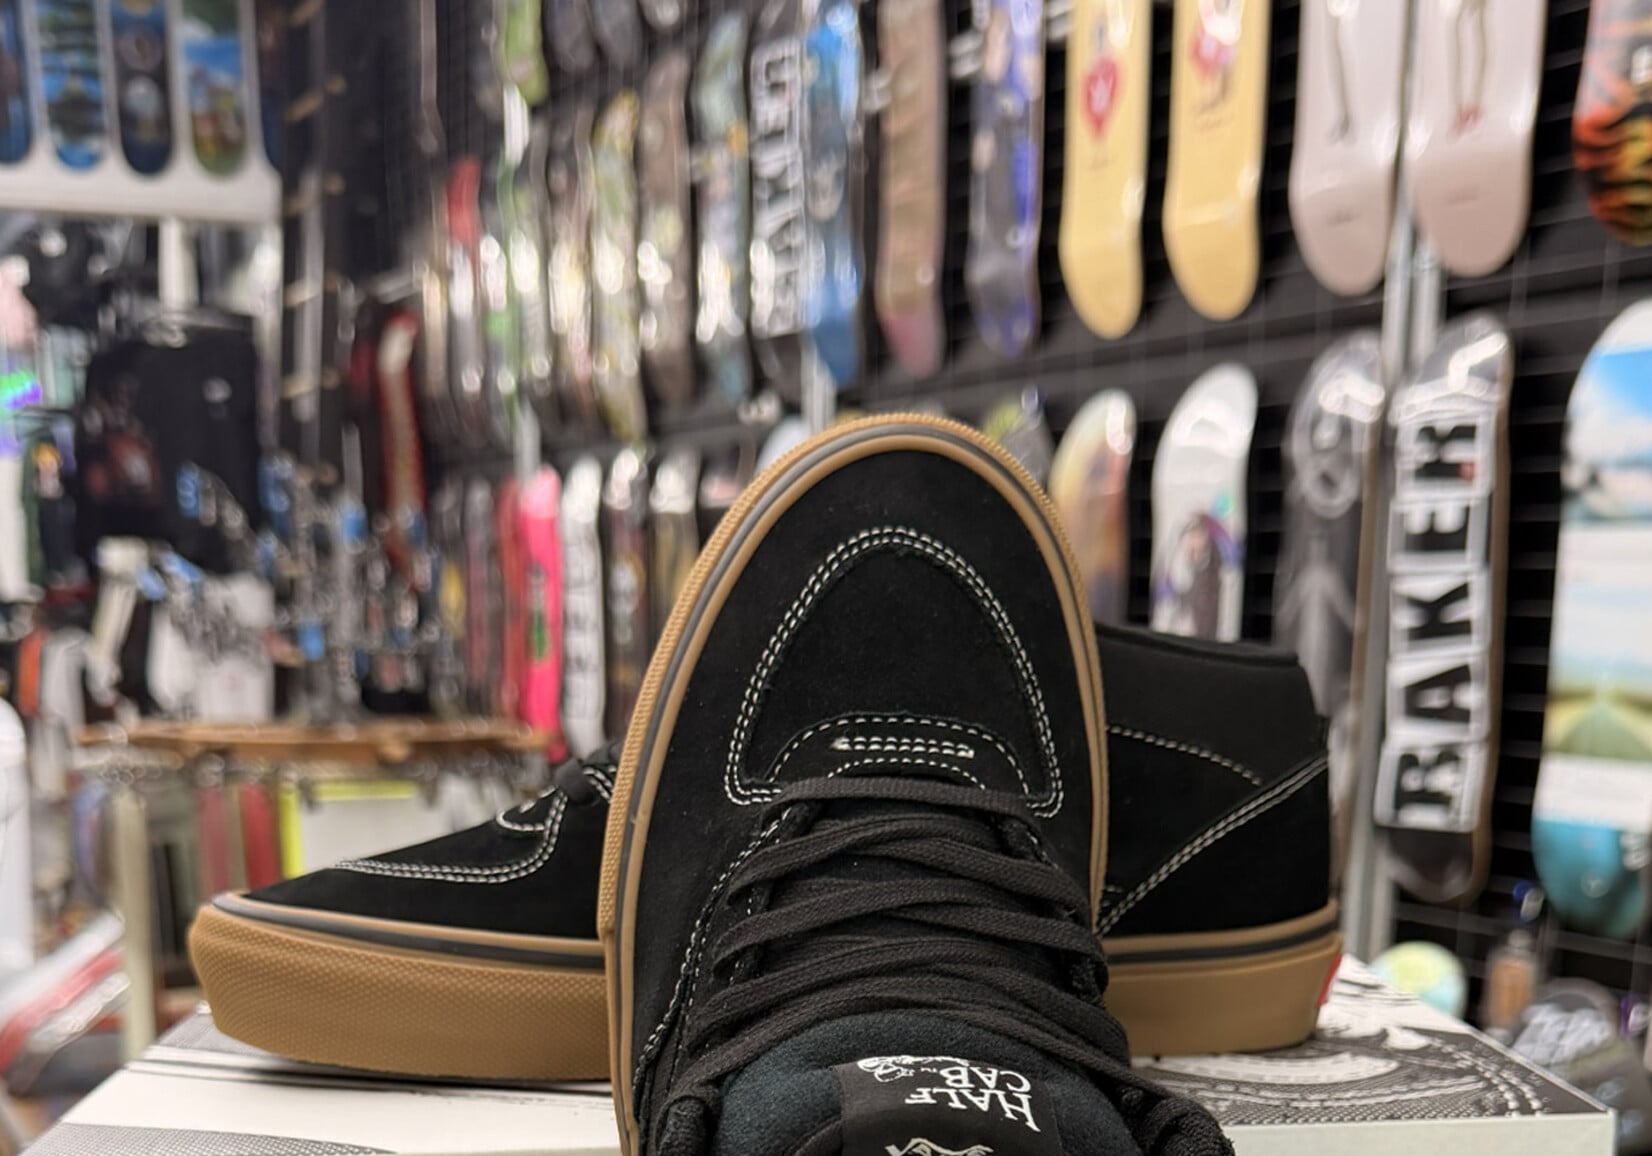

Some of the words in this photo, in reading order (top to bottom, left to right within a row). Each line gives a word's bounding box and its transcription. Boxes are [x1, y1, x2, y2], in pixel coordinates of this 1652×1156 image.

[1391, 416, 1482, 815] BAKER
[939, 1065, 1032, 1094] CAB
[904, 1087, 1042, 1133] HALF
